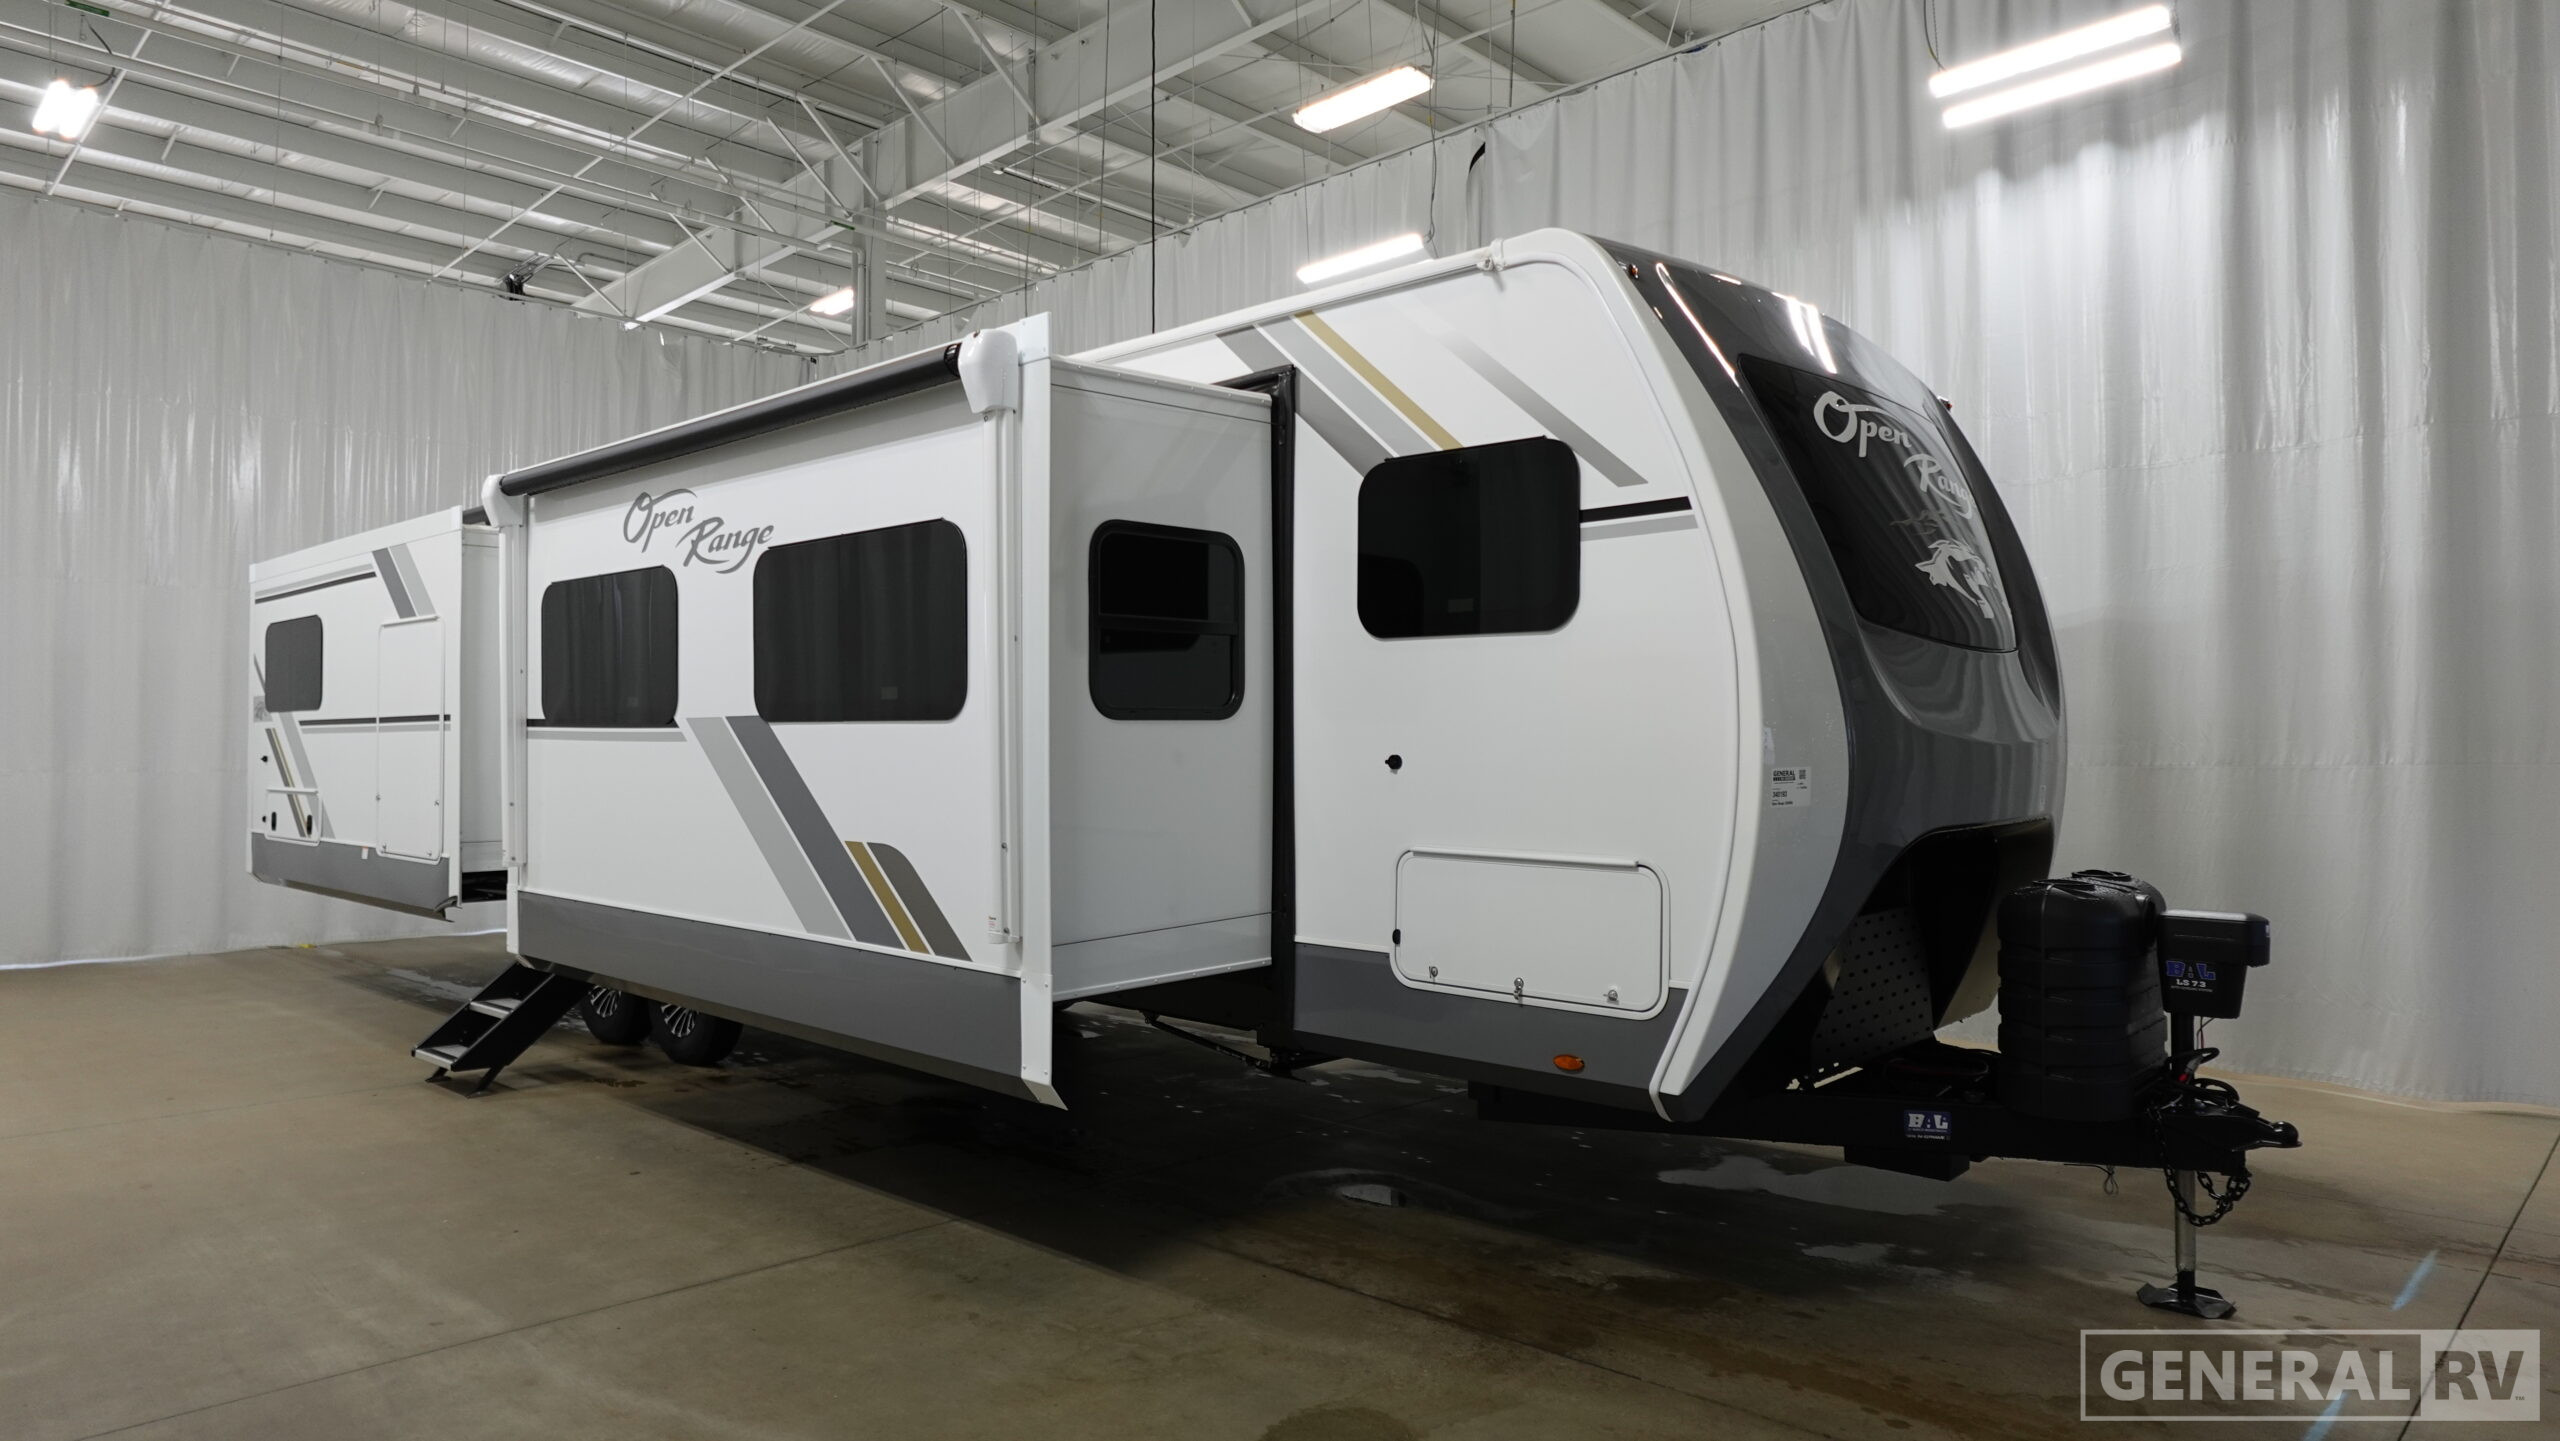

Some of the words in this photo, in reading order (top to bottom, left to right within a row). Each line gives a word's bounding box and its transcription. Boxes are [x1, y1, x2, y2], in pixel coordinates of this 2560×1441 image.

[1813, 390, 1912, 457] Open
[1903, 453, 1973, 520] Rang
[623, 488, 698, 553] Open
[675, 516, 774, 574] Range
[2166, 960, 2217, 981] BAL
